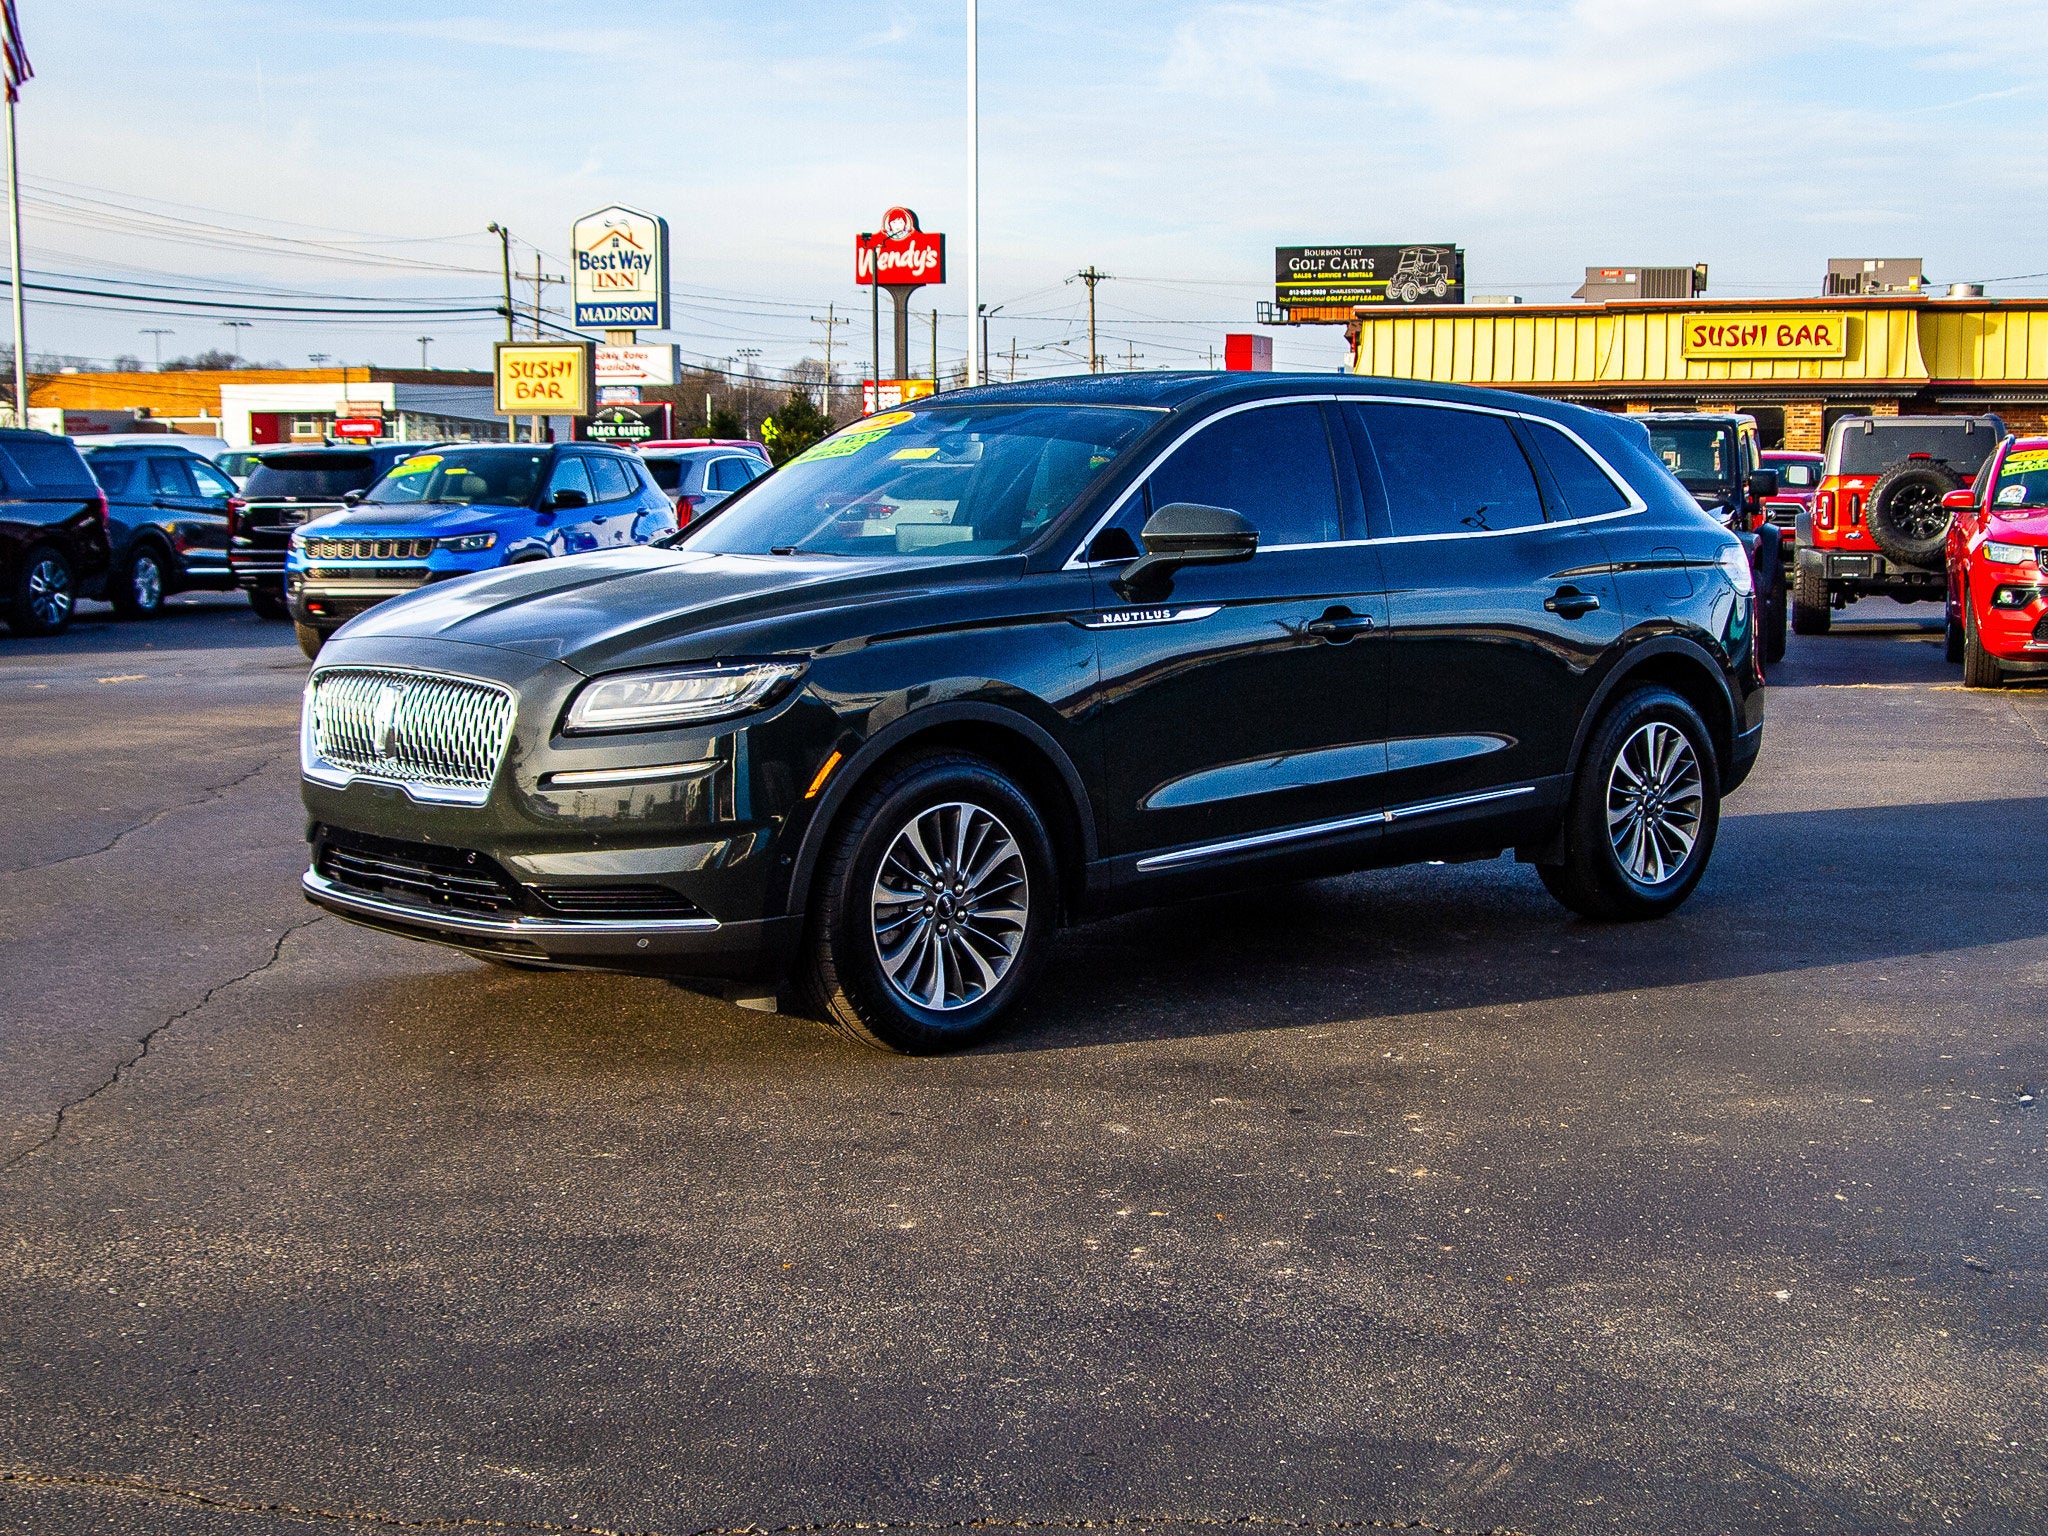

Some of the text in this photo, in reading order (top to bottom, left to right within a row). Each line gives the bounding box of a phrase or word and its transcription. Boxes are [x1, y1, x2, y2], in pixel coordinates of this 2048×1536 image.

[858, 240, 938, 277] Wendy's
[1304, 247, 1363, 257] BOURBON CITY
[579, 251, 652, 275] Best Way
[1289, 257, 1375, 271] GOLF CARTS
[596, 272, 634, 288] INN
[579, 306, 654, 322] MADISON
[1692, 324, 1833, 347] SUSHI BAR
[595, 352, 619, 360] eekly
[509, 361, 572, 379] SUSHI
[516, 383, 563, 399] BAR
[586, 425, 651, 437] BLACK OLIVES
[1102, 609, 1171, 623] NAUTILUS
